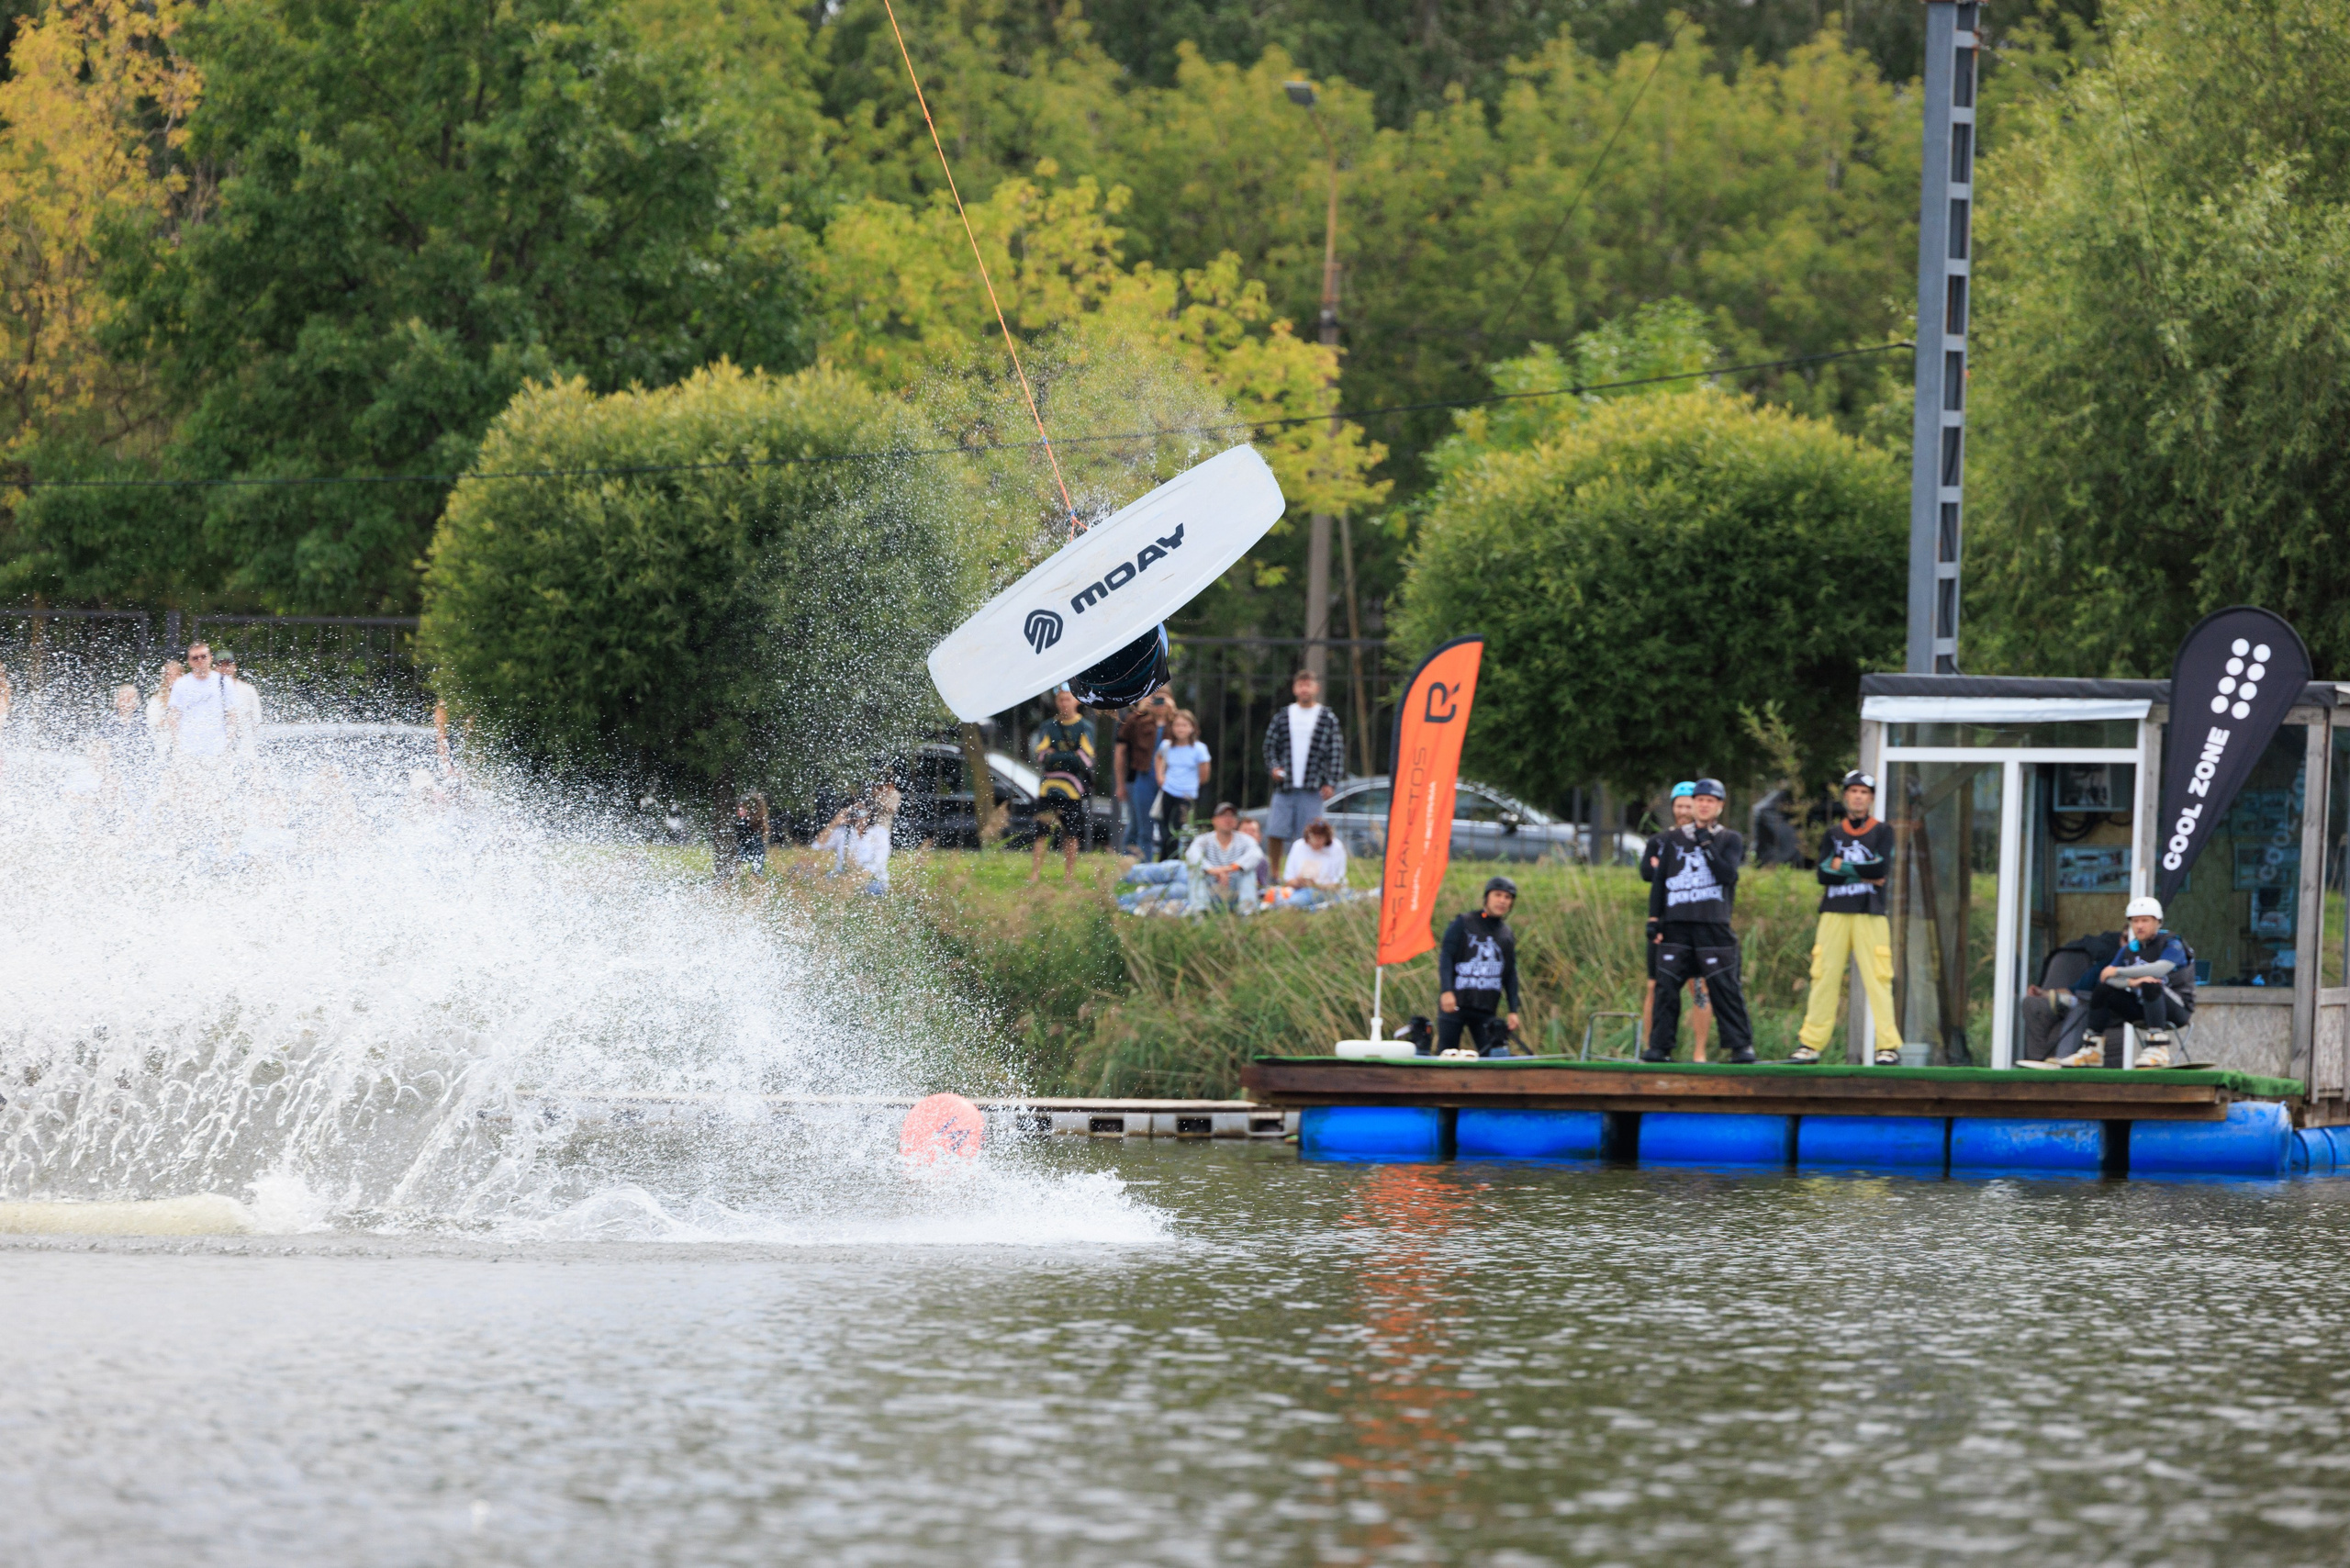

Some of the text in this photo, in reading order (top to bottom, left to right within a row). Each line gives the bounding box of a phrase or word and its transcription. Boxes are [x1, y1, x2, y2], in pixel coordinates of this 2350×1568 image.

[1070, 522, 1185, 614] MOAY
[2163, 726, 2231, 870] COOL ZONE
